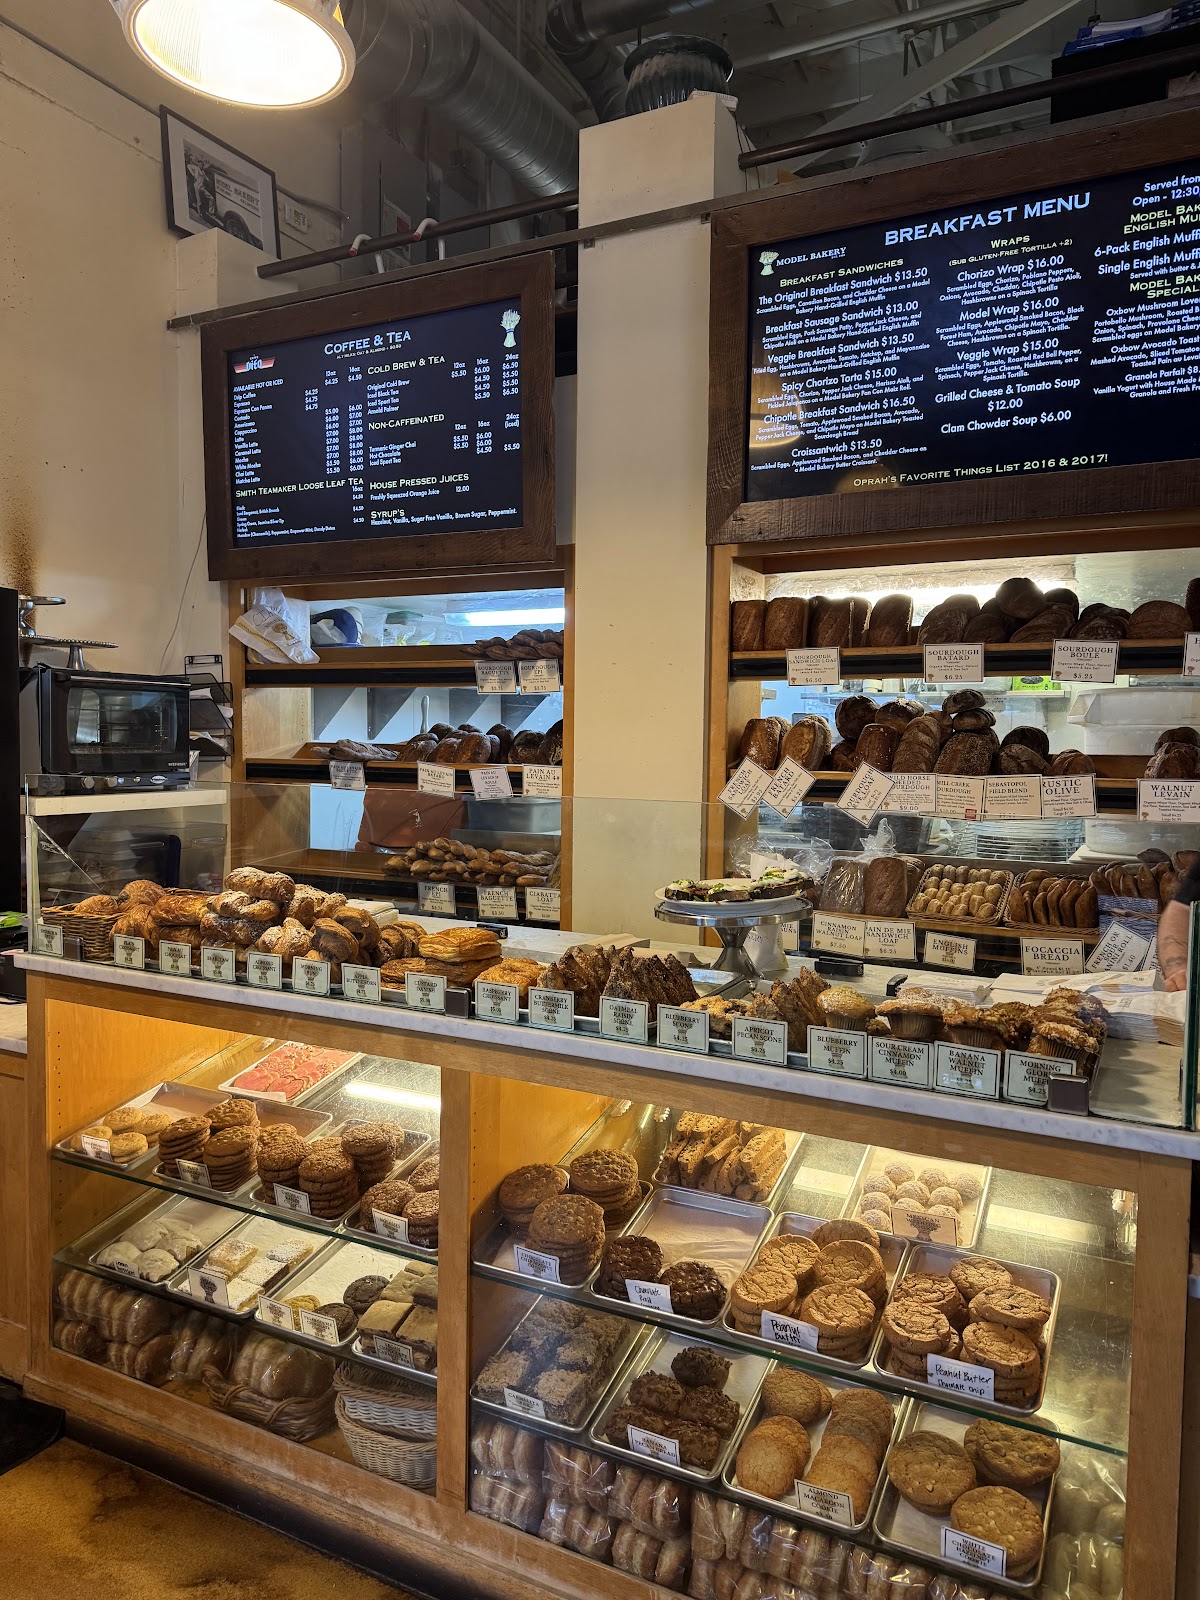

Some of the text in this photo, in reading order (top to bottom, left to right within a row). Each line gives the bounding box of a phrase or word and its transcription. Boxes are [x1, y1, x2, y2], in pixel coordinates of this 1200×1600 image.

[885, 192, 1090, 245] BREAKFAST MENU
[1131, 210, 1172, 223] MODEL
[1124, 218, 1175, 234] ENGLISH
[991, 236, 1030, 248] WRAPS
[1094, 236, 1170, 257] 6-Pack English
[775, 255, 808, 266] MODEL
[810, 247, 846, 260] BAKERY
[968, 249, 1018, 262] GLUTEN-FREE
[1021, 242, 1057, 253] TORTILLA
[958, 255, 1064, 281] Chorizo Wrap $16.00
[1098, 254, 1170, 274] Single English
[780, 259, 903, 287] BREAKFAST SANDWICHES
[759, 268, 927, 305] The Original Breakfast Sandwich $13.50
[960, 297, 1059, 321] Model Wrap $16.00
[766, 301, 918, 334] Breakfast Sausage Sandwich $13.00
[324, 331, 411, 354] COFFEE & TEA
[768, 333, 914, 363] Veggie Breakfast Sandwich $13.50
[957, 338, 1059, 361] Veggie Wrap $15.00
[368, 365, 390, 374] COLD
[393, 360, 416, 370] BREW
[780, 367, 897, 393] Spicy Chorizo Torta $15.00
[935, 379, 1080, 403] Grilled Cheese & Tomato Soup
[762, 396, 915, 426] Chipotle Breakfast Sandwich $16.50
[988, 398, 1023, 412] $12.00
[369, 414, 444, 430] NON-CAFFEINATED
[941, 410, 1071, 433] Clam Chowder Soup $6.00
[792, 439, 882, 457] Croissantwich $13.50
[851, 454, 1108, 487] OPRAH'S FAVORITE THINGS LIST 2016 & 2017!
[258, 485, 296, 494] TEAMAKER
[299, 482, 324, 490] LOOSE
[326, 480, 346, 488] LEAF
[348, 478, 364, 487] TEA
[370, 474, 469, 490] HOUSE PRESSED JUICES
[371, 509, 405, 518] SYRUP'S
[1058, 646, 1114, 654] SOURDOUGH
[768, 768, 790, 796] FRENCH
[772, 771, 797, 800] BATARD
[1046, 787, 1080, 795] OLIVE
[816, 929, 845, 938] WALNUT
[820, 921, 857, 931] CINNAMON
[932, 945, 968, 955] MUFFINS
[933, 939, 968, 950] ENGLISH
[1025, 945, 1080, 954] FOCACCIA
[1092, 931, 1120, 969] FRENCH OR
[1119, 934, 1132, 952] ROLL
[665, 1013, 701, 1024] BLUEBERRY
[744, 1026, 774, 1036] APRICOT
[760, 1034, 782, 1044] SCONE
[817, 1035, 858, 1047] BLUEBERRY
[823, 1046, 851, 1055] MUFFIN
[876, 1041, 925, 1055] SOUR CREAM
[878, 1048, 921, 1060] CINNAMON
[949, 1049, 986, 1062] BANANA
[885, 1057, 914, 1066] MUFFIN
[948, 1056, 986, 1070] WALNUT
[1020, 1060, 1061, 1072] MORNING
[949, 1064, 983, 1076] MUFFIN
[1028, 1086, 1046, 1095] $4.25
[935, 1364, 992, 1385] Peanut Butter
[804, 1493, 845, 1508] MACAROON
[808, 1488, 839, 1500] ALMOND
[962, 1538, 986, 1552] WHITE
